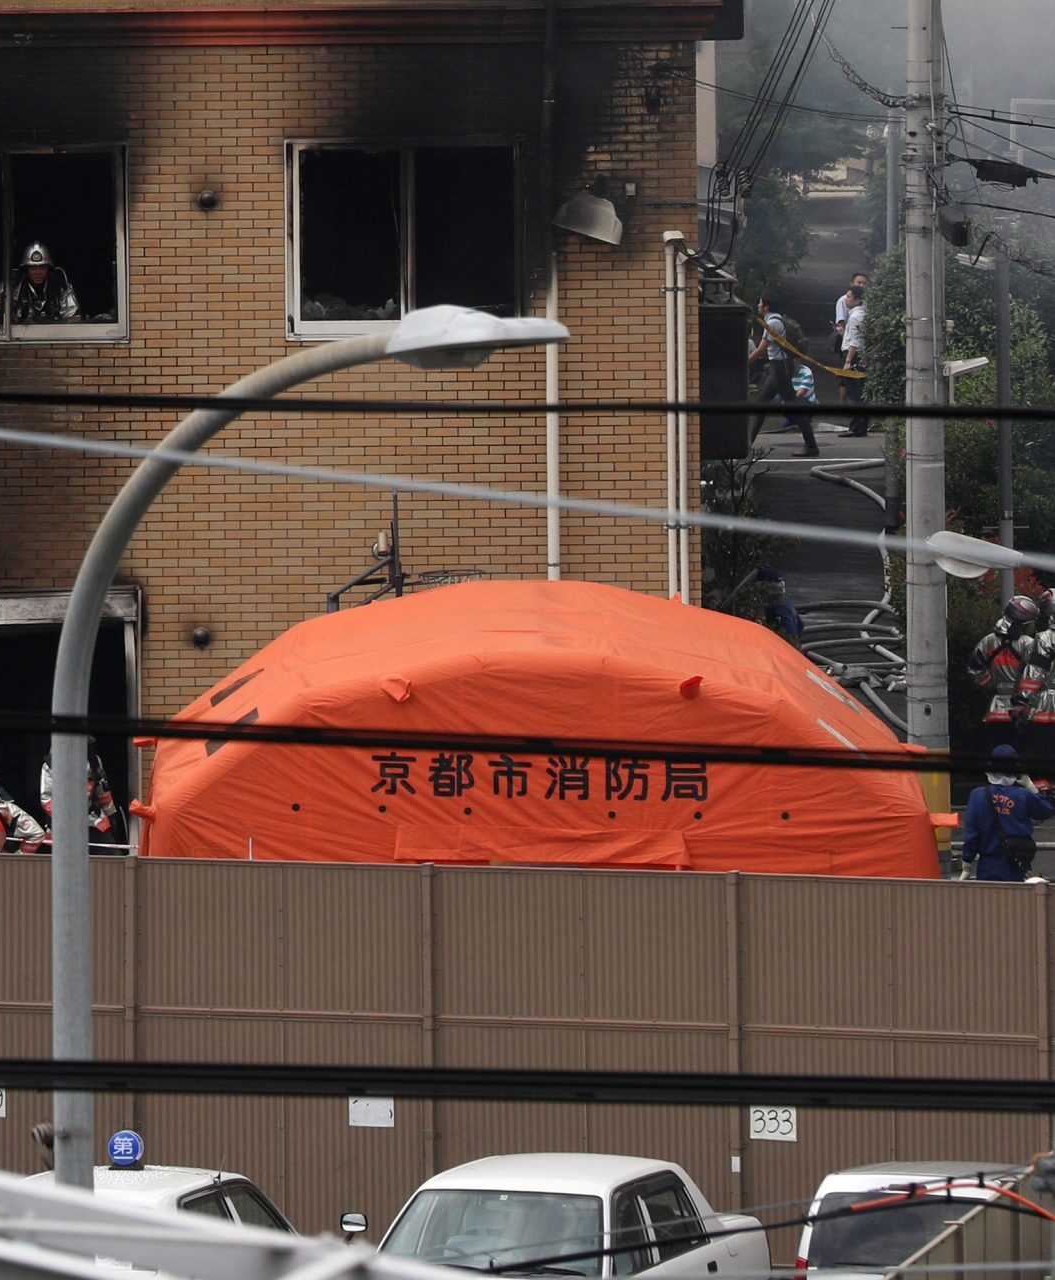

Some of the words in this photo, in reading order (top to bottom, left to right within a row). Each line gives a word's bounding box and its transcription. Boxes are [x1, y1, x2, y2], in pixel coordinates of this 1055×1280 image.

[371, 752, 708, 802] 京都市消防局
[753, 1109, 794, 1136] 333
[113, 1136, 134, 1160] 第一
